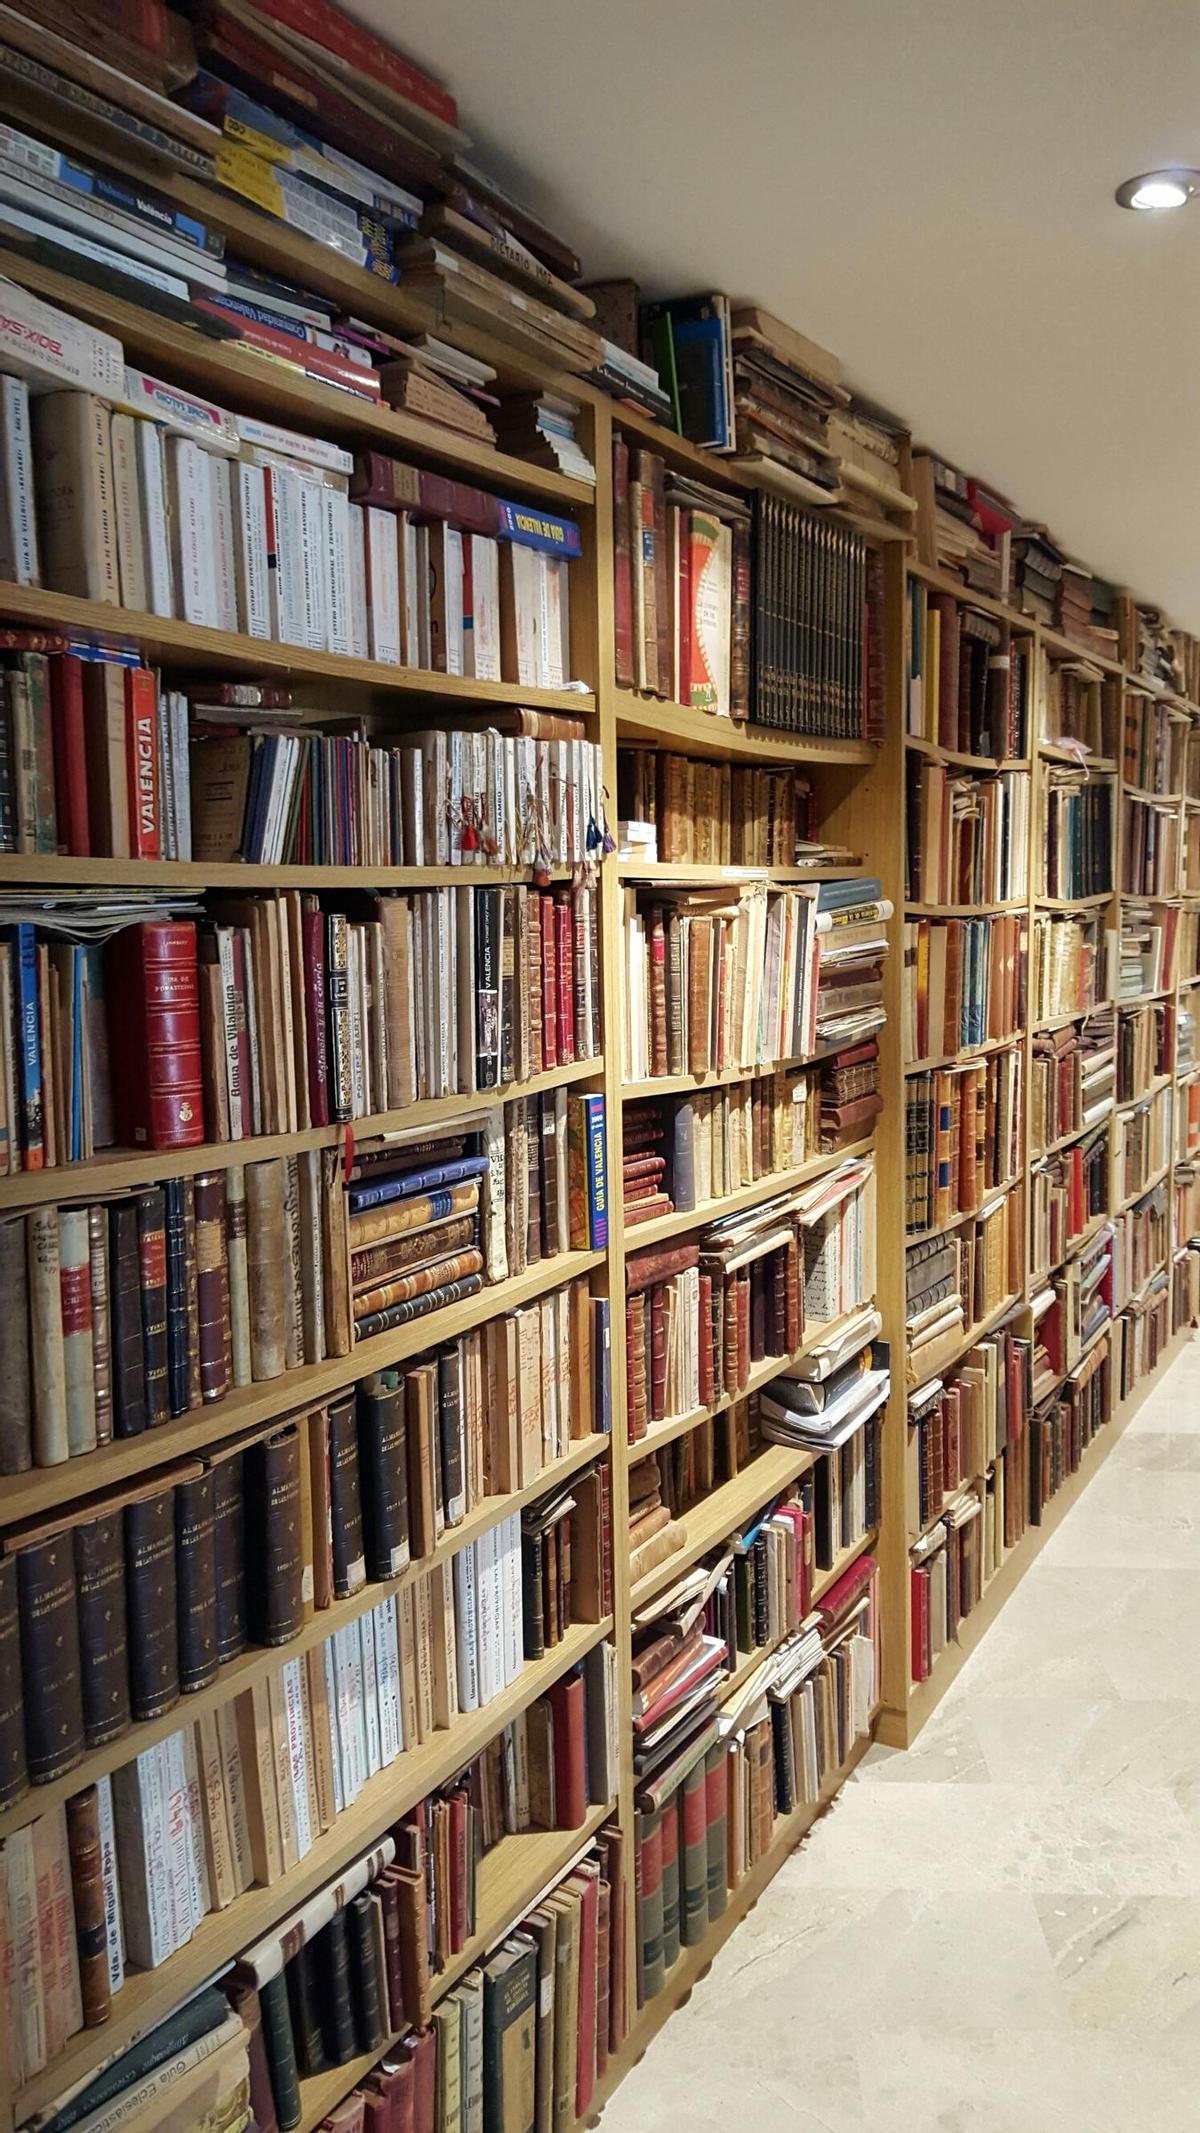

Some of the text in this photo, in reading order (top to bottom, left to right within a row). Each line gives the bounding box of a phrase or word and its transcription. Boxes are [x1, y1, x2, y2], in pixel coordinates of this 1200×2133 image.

[327, 501, 335, 545] TRANSPORTES
[137, 717, 155, 836] VALENCIA
[483, 946, 493, 989] VALENCIA
[25, 1001, 38, 1066] VALENCIA
[228, 1045, 239, 1060] de
[591, 1131, 606, 1212] GUÍA DE VALENCIA
[467, 1658, 476, 1667] de
[286, 1678, 298, 1749] PROVINCIAS
[211, 1823, 224, 1881] MIGUEL
[232, 1807, 244, 1863] MIGUEL
[104, 1879, 117, 1925] Miguel
[108, 1928, 118, 1946] de
[108, 1950, 121, 1982] Vda.
